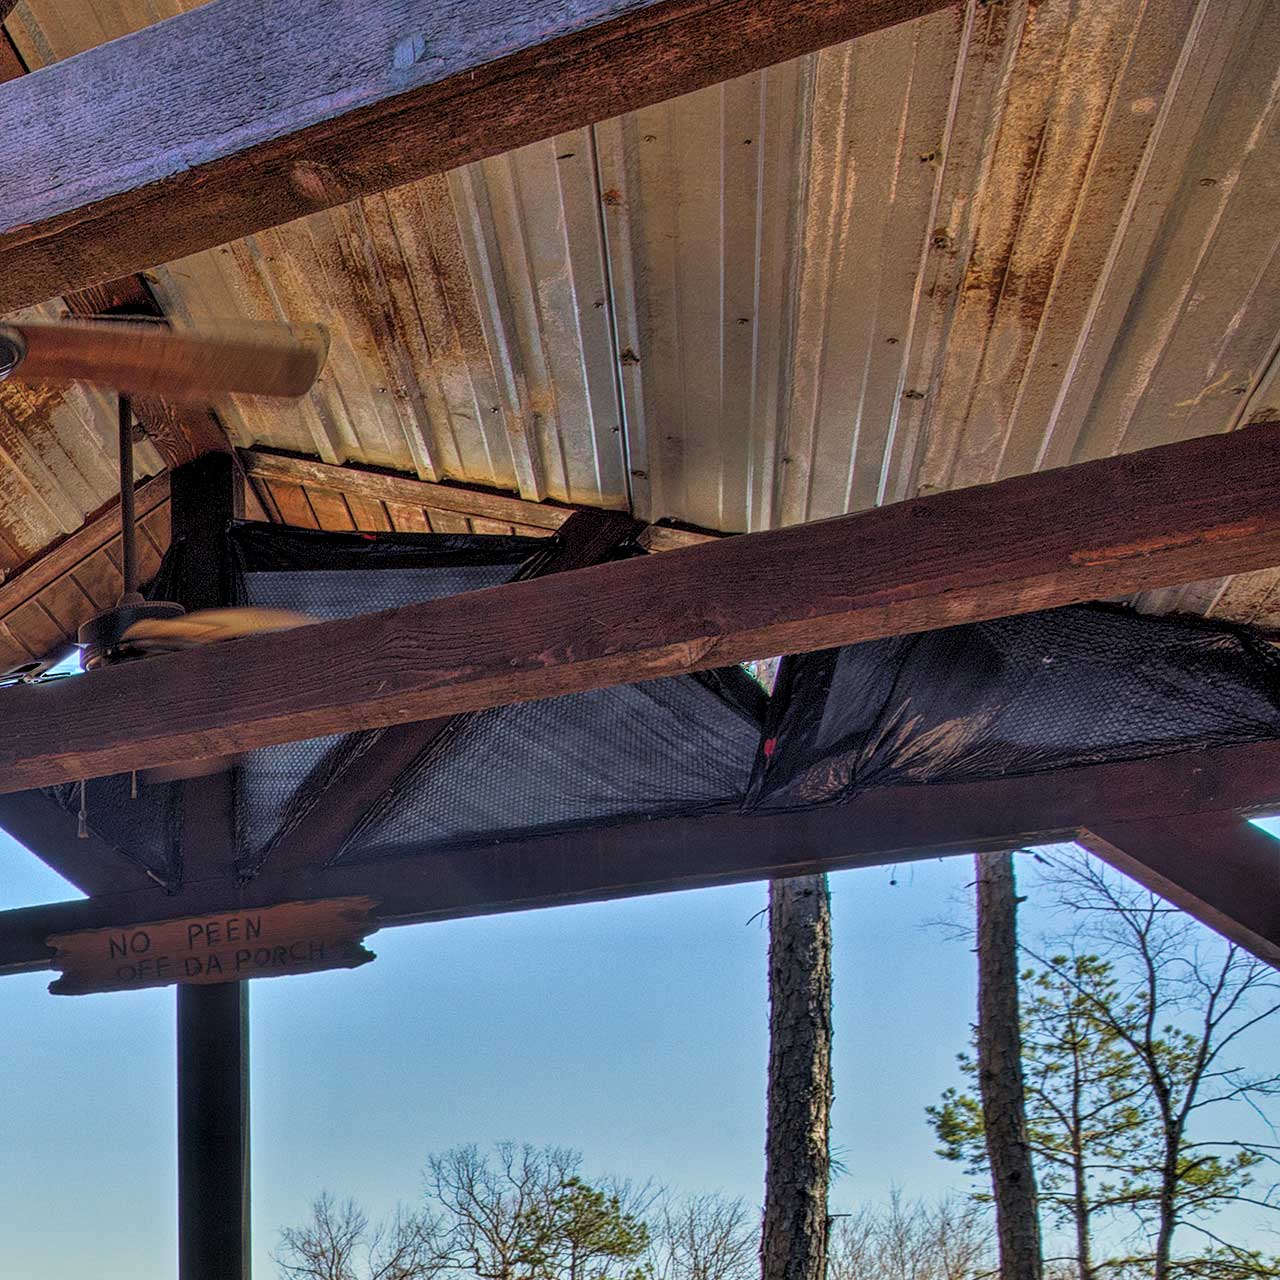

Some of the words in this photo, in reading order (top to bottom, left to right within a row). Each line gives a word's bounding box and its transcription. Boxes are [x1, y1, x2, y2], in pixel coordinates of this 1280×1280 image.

[109, 931, 151, 959] NO
[187, 916, 262, 950] PEEN
[116, 956, 170, 983] OFF
[184, 954, 223, 977] DA
[235, 936, 326, 972] PORCH
